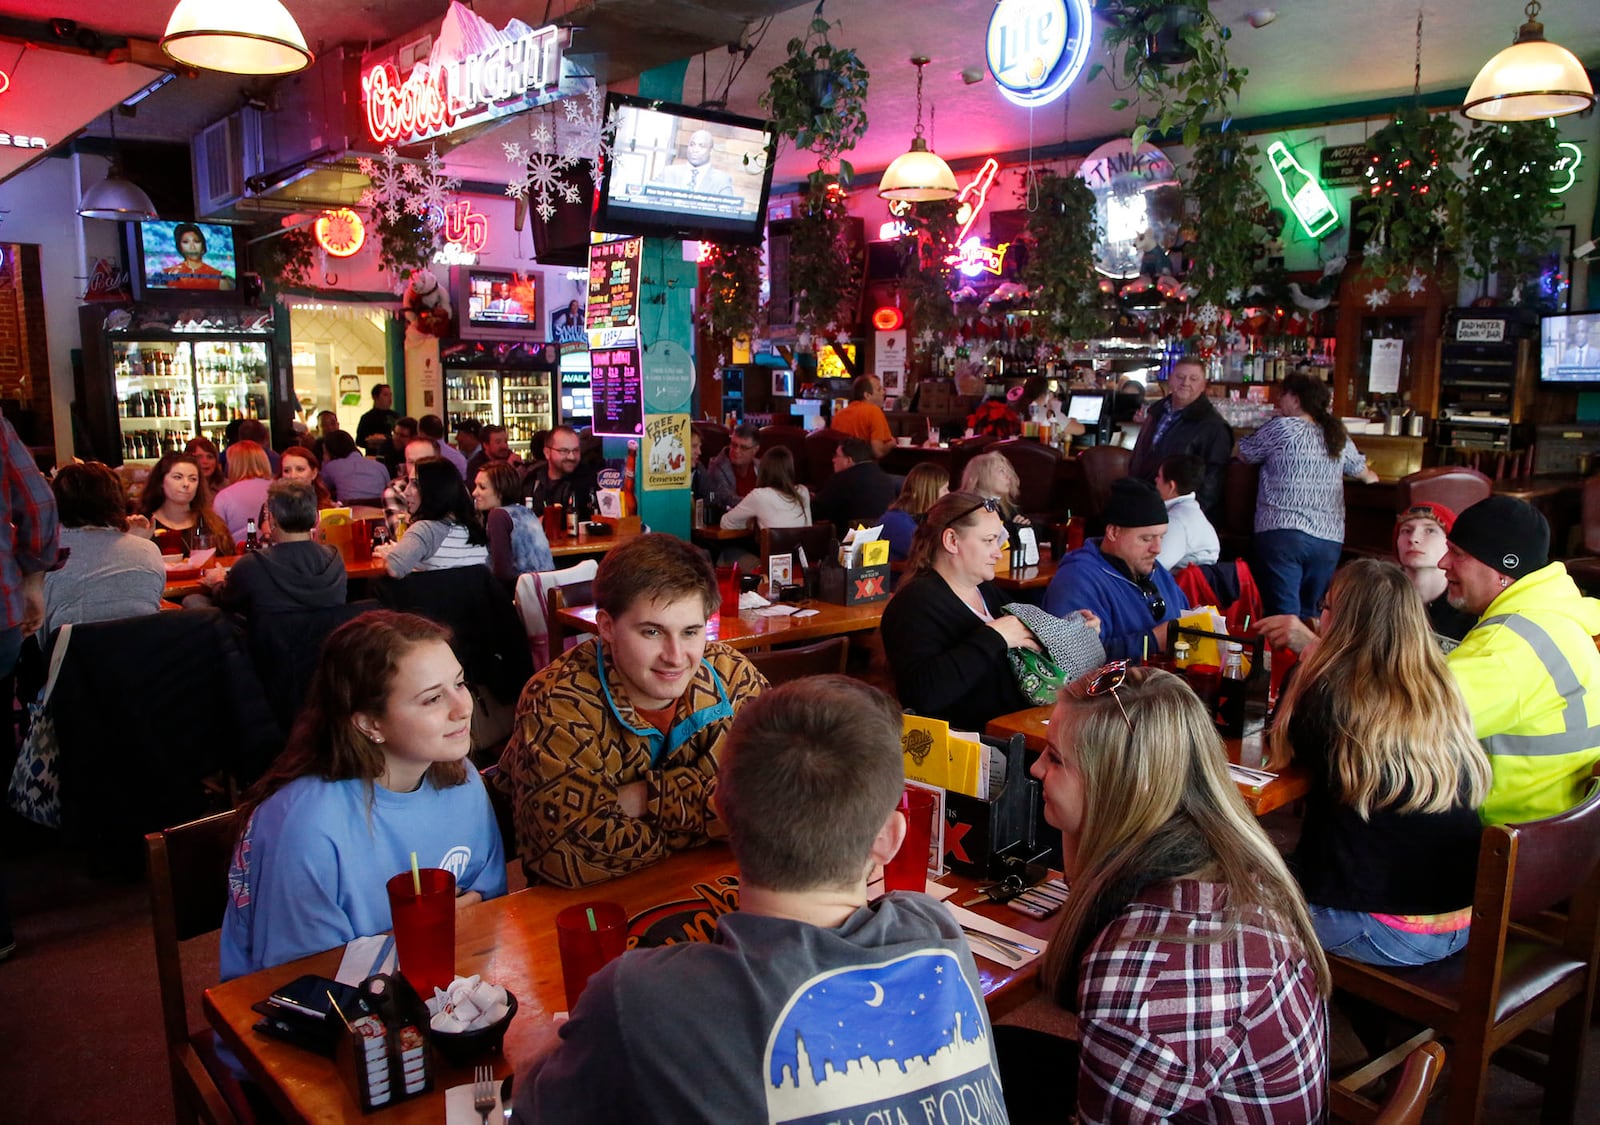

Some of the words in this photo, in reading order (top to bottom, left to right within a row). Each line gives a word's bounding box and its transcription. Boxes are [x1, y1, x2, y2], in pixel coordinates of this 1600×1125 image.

[362, 63, 446, 141] Coors
[447, 25, 562, 115] LIGHT
[327, 209, 354, 225] BUD
[446, 201, 488, 253] UD
[322, 233, 356, 251] LIGHT
[90, 271, 129, 292] Bass
[645, 415, 673, 439] FREE
[654, 419, 686, 447] BEER!
[600, 478, 623, 486] LIGHT
[854, 575, 885, 599] XX
[944, 822, 973, 865] X
